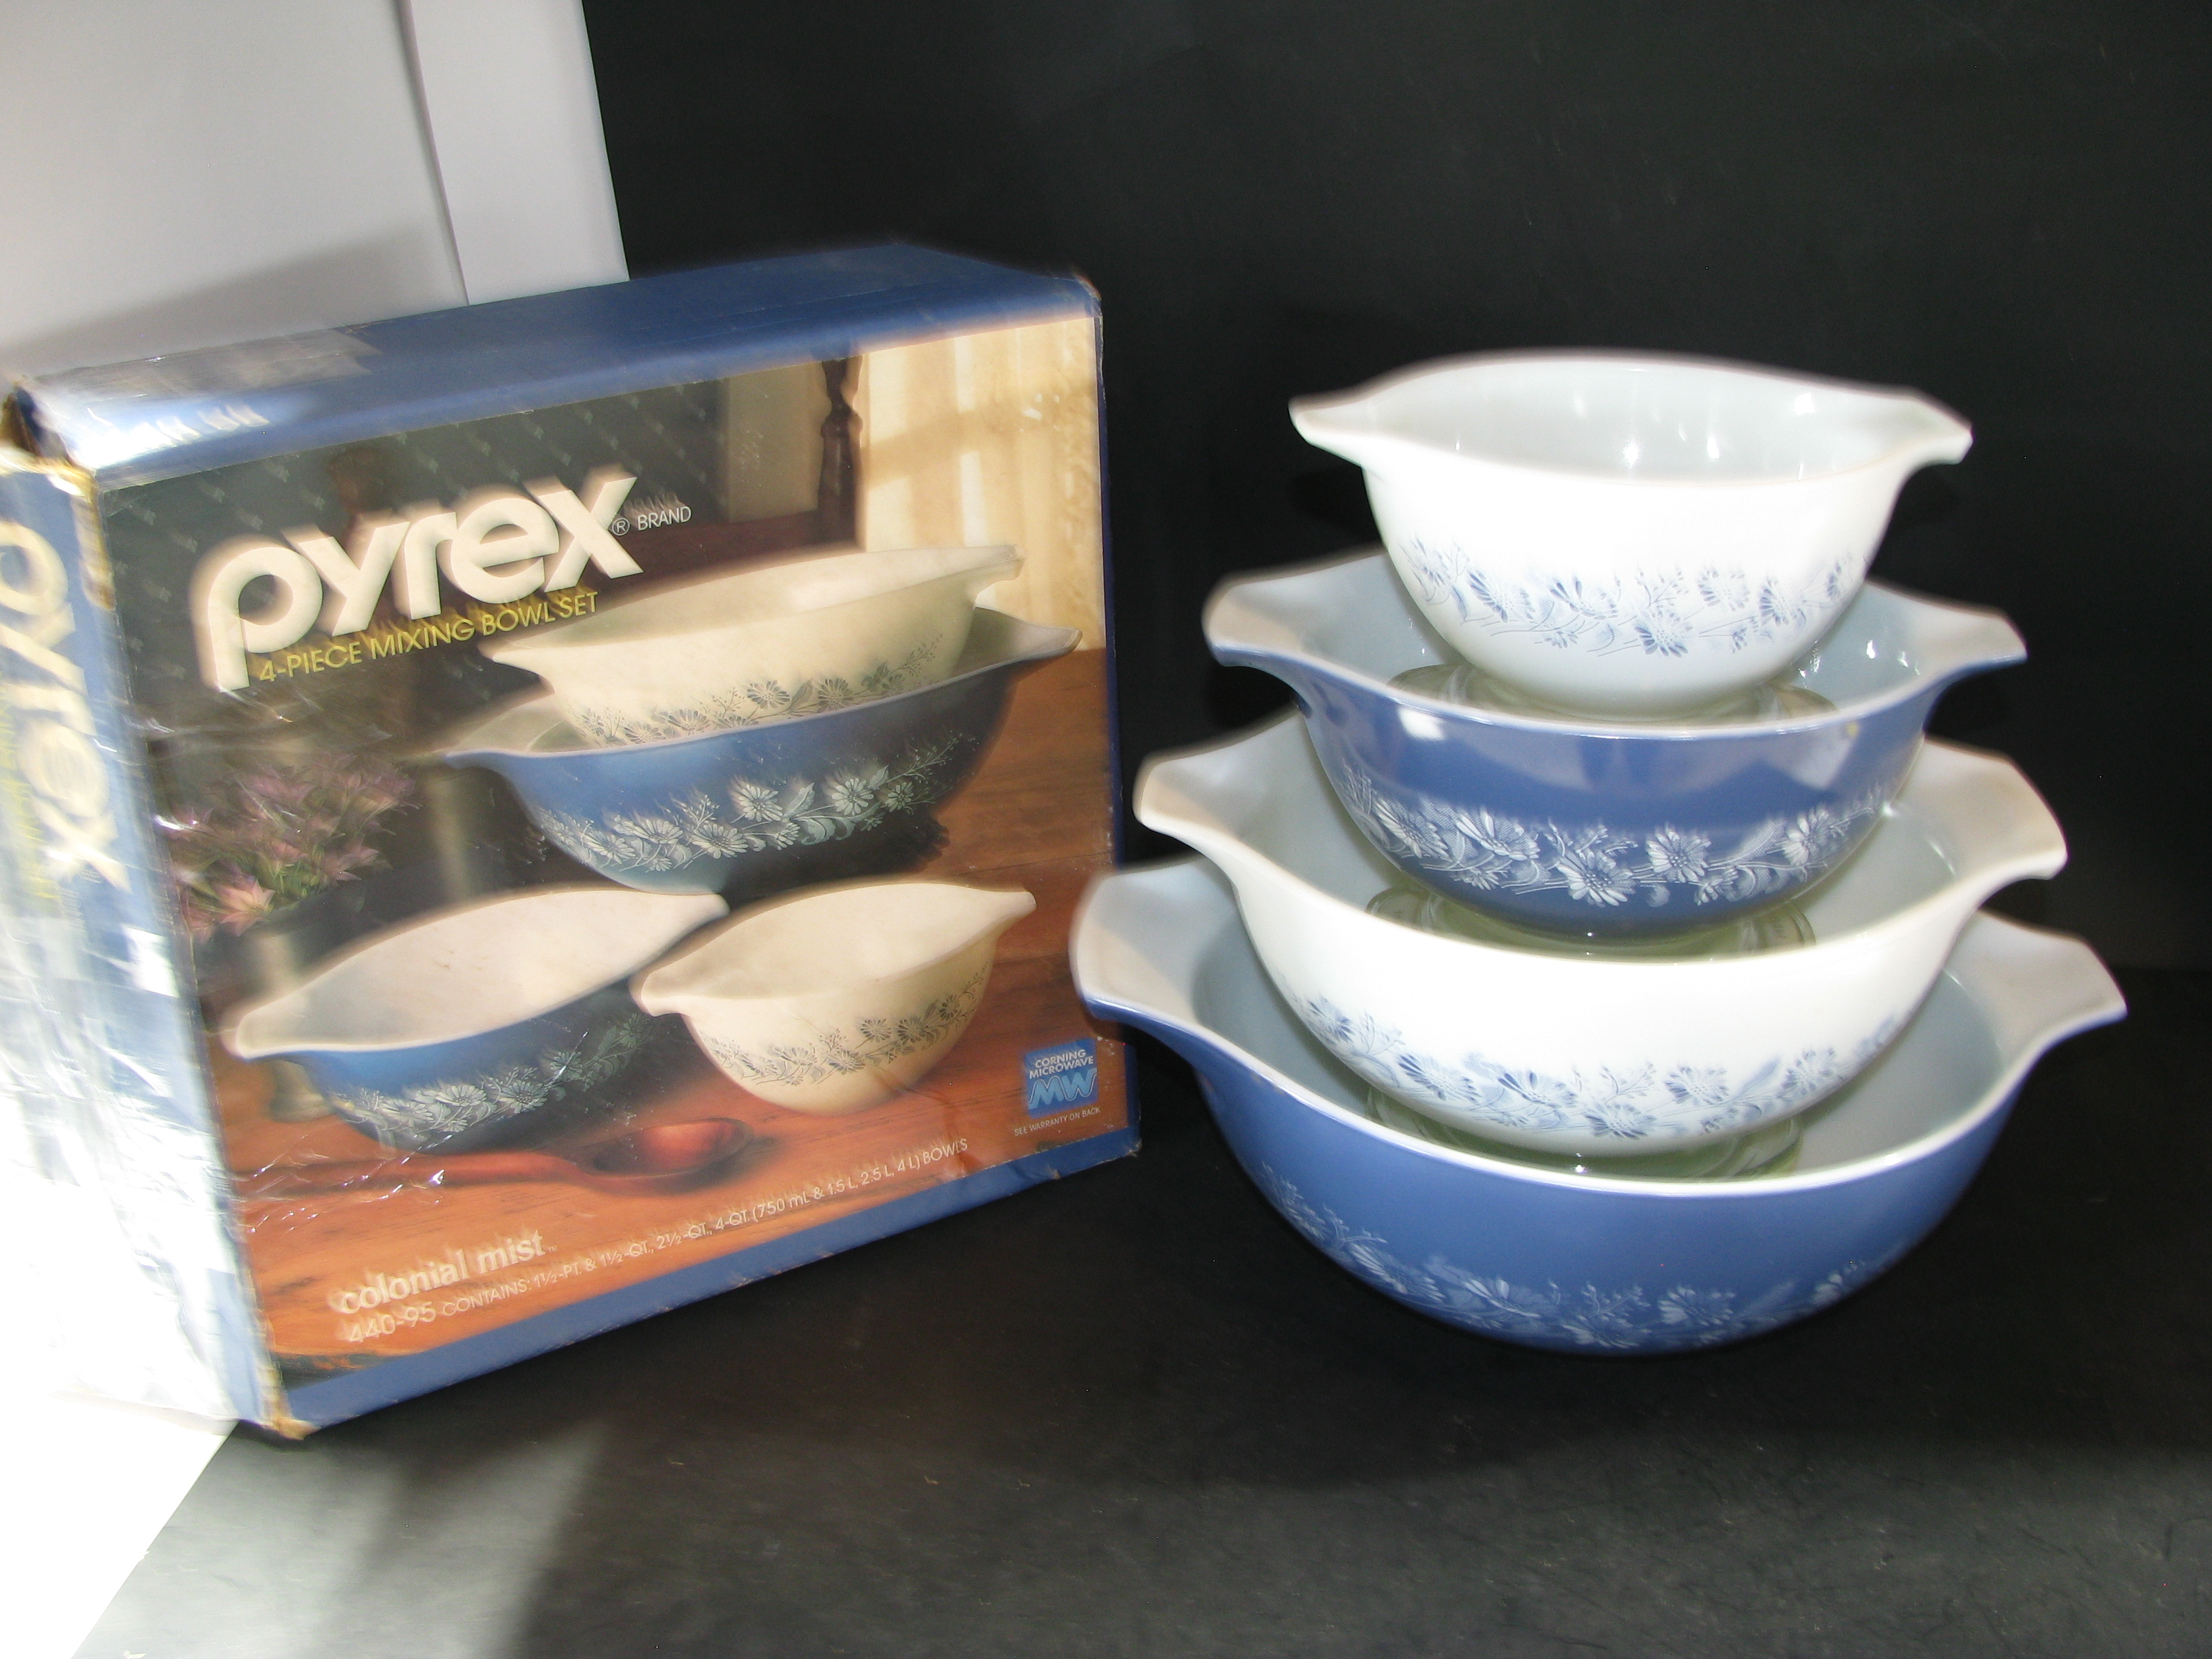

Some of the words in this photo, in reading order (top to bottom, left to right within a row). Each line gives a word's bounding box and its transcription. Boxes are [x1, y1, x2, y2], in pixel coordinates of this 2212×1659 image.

[205, 476, 643, 693] pyrex
[636, 506, 691, 531] BRAND
[260, 641, 363, 682] 4-PIECE
[371, 617, 475, 659] MIXING
[482, 598, 558, 634] BOWL
[559, 592, 598, 617] SET
[1029, 1055, 1094, 1079] MICROWAVE
[1034, 1048, 1086, 1069] CORNING
[1015, 1126, 1028, 1136] SEE
[1029, 1115, 1068, 1131] WARRANTY
[1069, 1111, 1080, 1121] ON
[1082, 1107, 1101, 1118] BACK
[339, 1248, 470, 1315] colonial
[478, 1229, 546, 1274] mist
[348, 1301, 437, 1344] 440-95
[442, 1279, 532, 1316] CONTAINS:
[586, 1258, 597, 1271] &
[752, 1198, 786, 1222] (750
[788, 1190, 812, 1208] mL
[813, 1186, 824, 1200] &
[827, 1179, 846, 1196] 1.5
[860, 1167, 882, 1185] 2.5
[897, 1158, 907, 1172] 4
[923, 1138, 968, 1166] BOWLS
